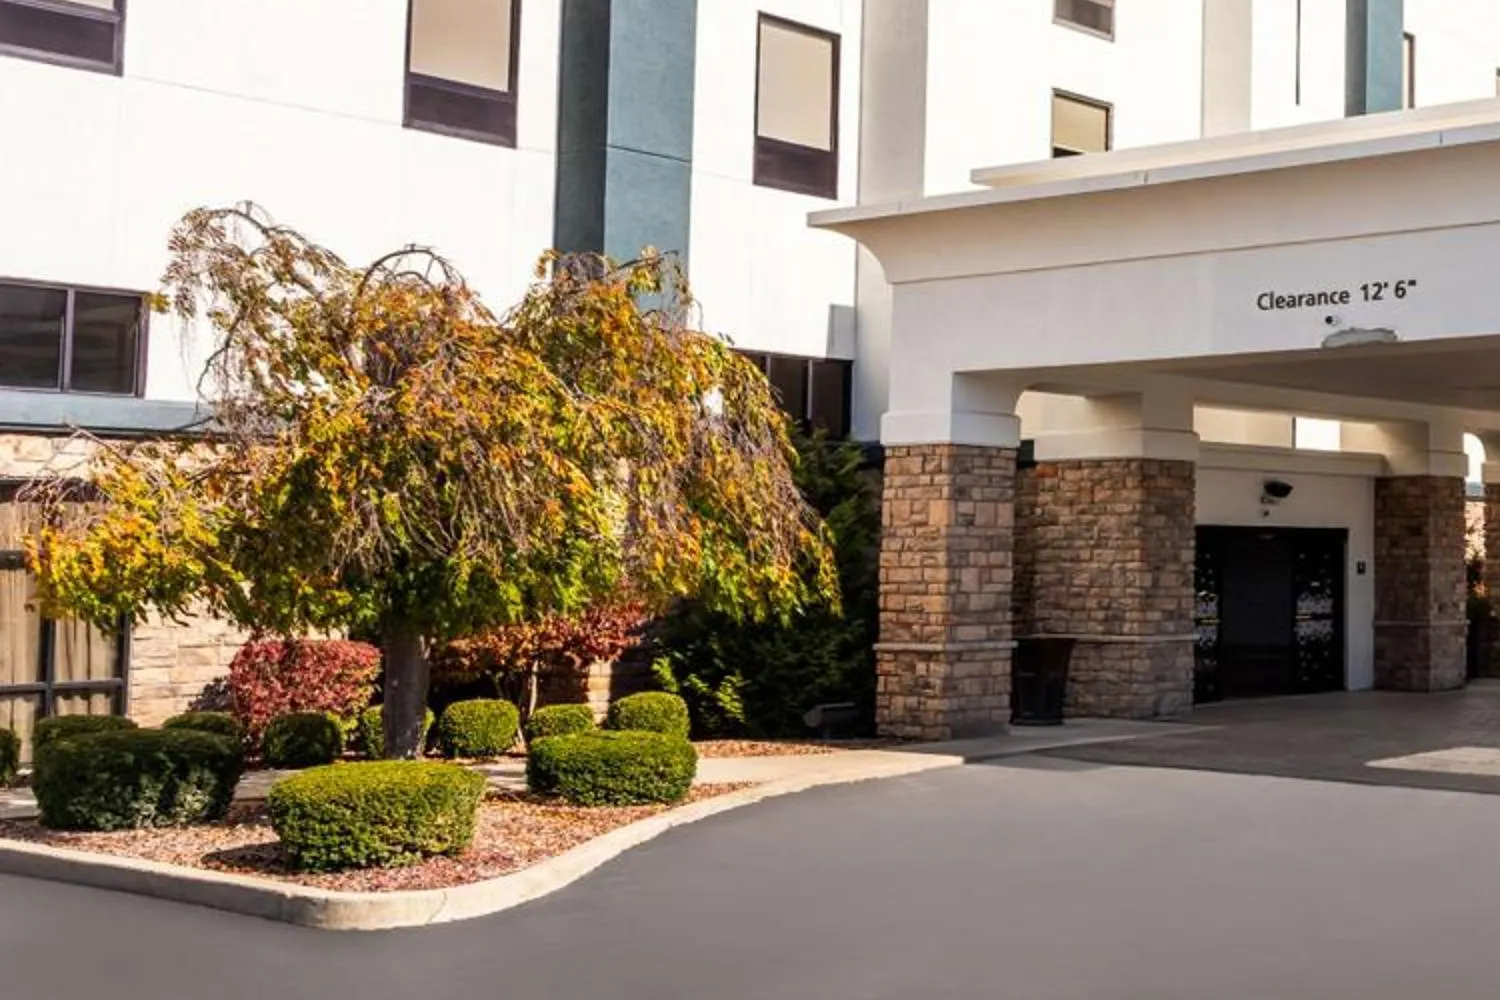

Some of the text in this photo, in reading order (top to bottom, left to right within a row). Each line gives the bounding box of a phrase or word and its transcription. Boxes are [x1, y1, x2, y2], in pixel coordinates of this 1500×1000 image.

[1257, 279, 1417, 311] Clearance 12' 6"
